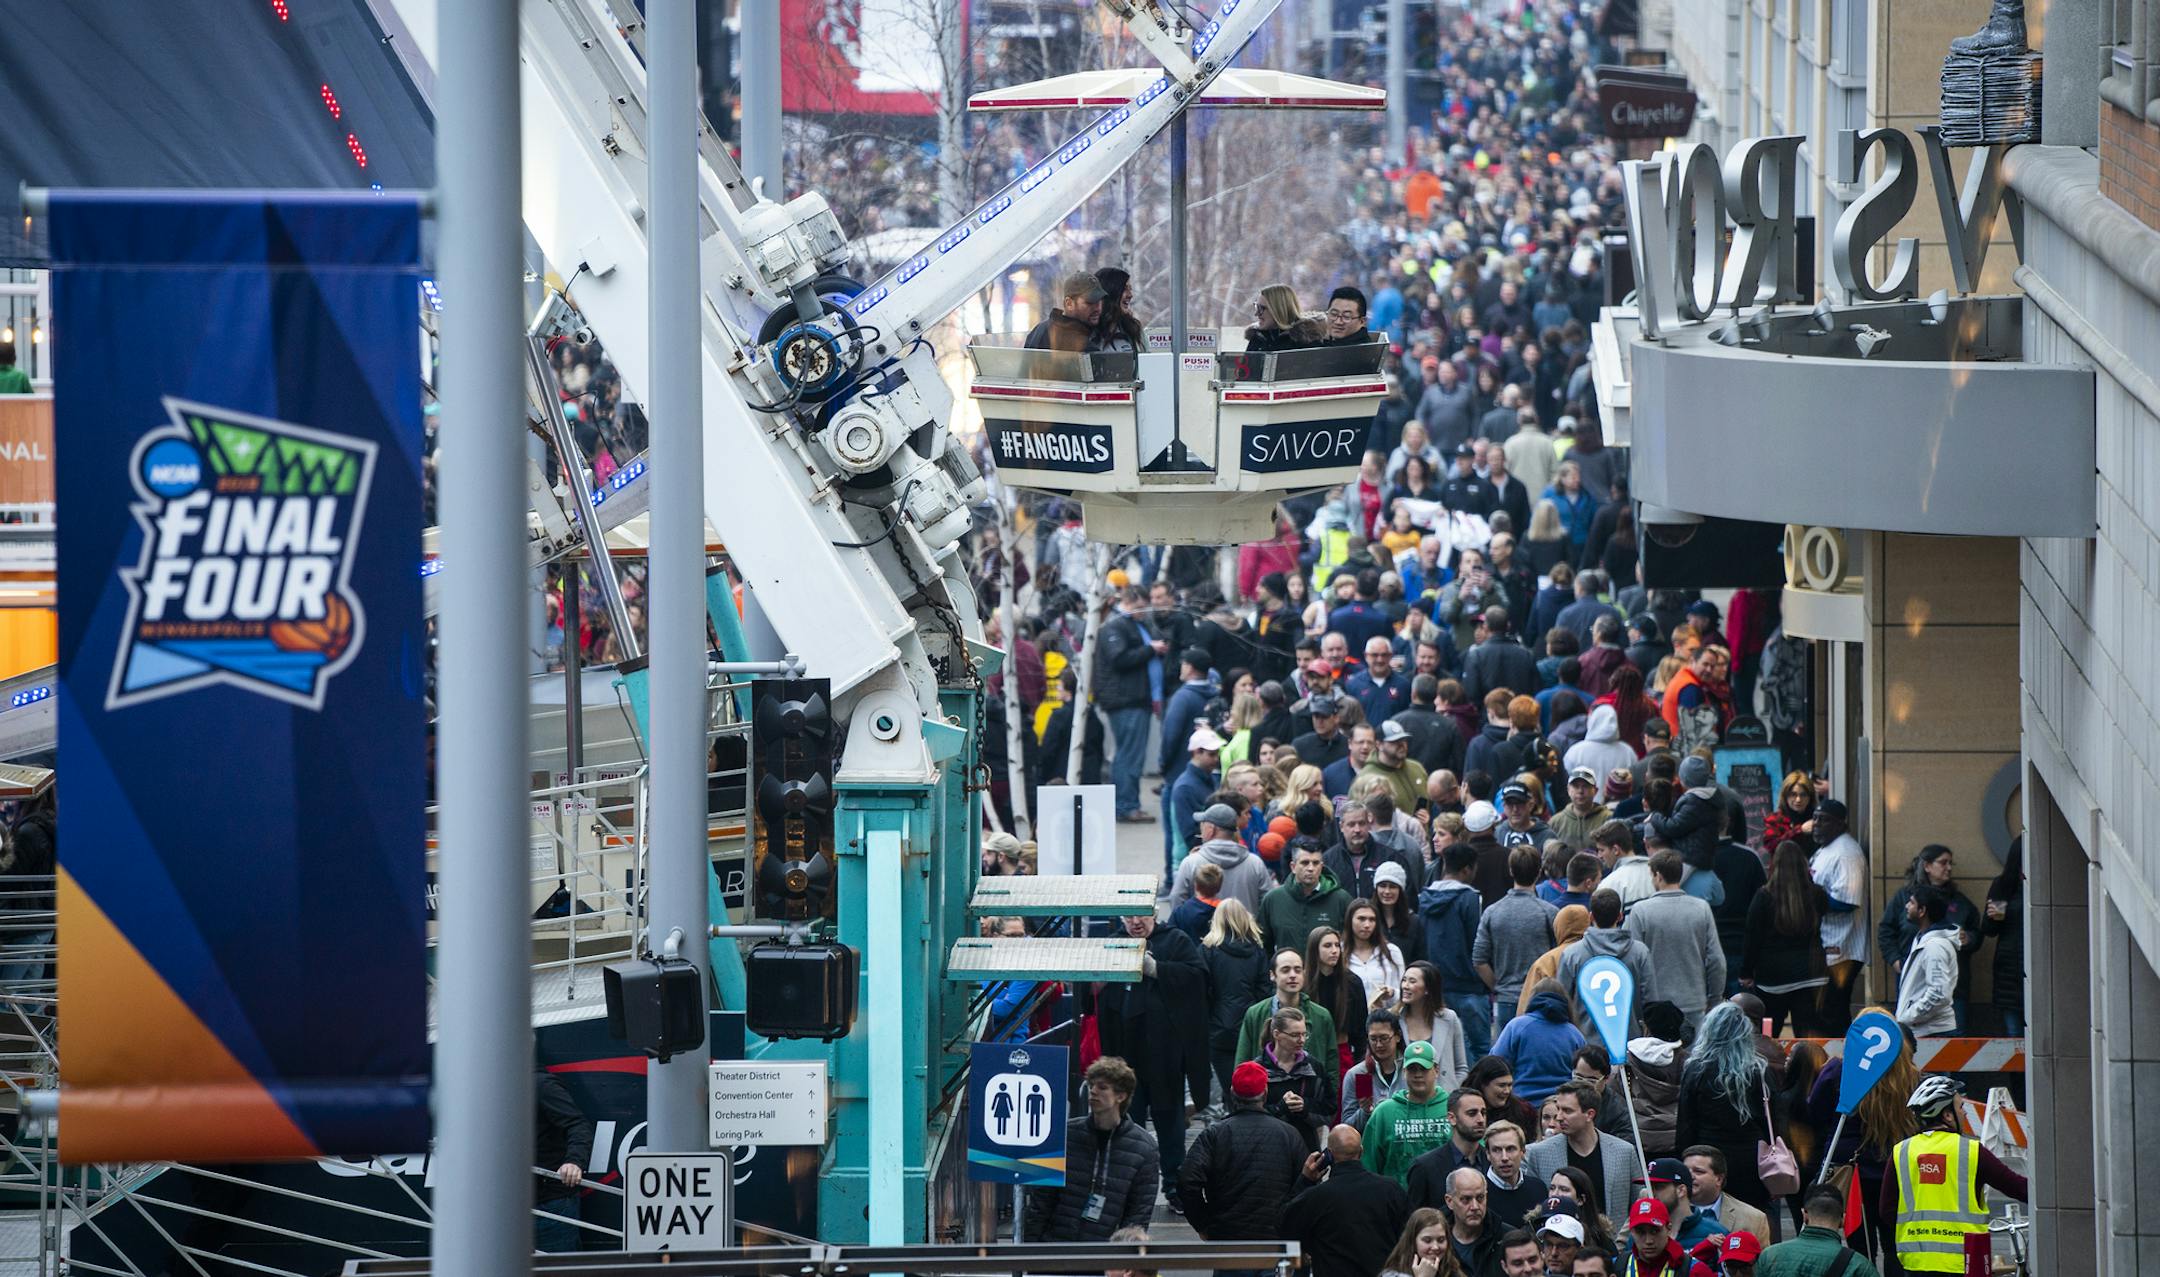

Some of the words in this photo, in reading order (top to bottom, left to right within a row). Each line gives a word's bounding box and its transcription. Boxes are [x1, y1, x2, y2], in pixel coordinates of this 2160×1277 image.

[1188, 334, 1214, 342] PULL
[1234, 355, 1250, 380] 8
[1001, 430, 1109, 463] #FANGOALS
[1248, 428, 1355, 463] SAVOR
[156, 489, 342, 557] FINAL
[143, 556, 334, 621] FOUR
[714, 1071, 748, 1081] Theater
[749, 1071, 781, 1081] District
[714, 1090, 763, 1101] Convention
[764, 1090, 794, 1100] Center
[714, 1110, 757, 1120] Orchestra
[758, 1110, 776, 1119] Hall
[715, 1130, 743, 1141] Loring
[743, 1129, 764, 1139] Park
[1394, 1123, 1452, 1138] HORNETS
[639, 1167, 713, 1199] ONE
[636, 1205, 715, 1236] WAY
